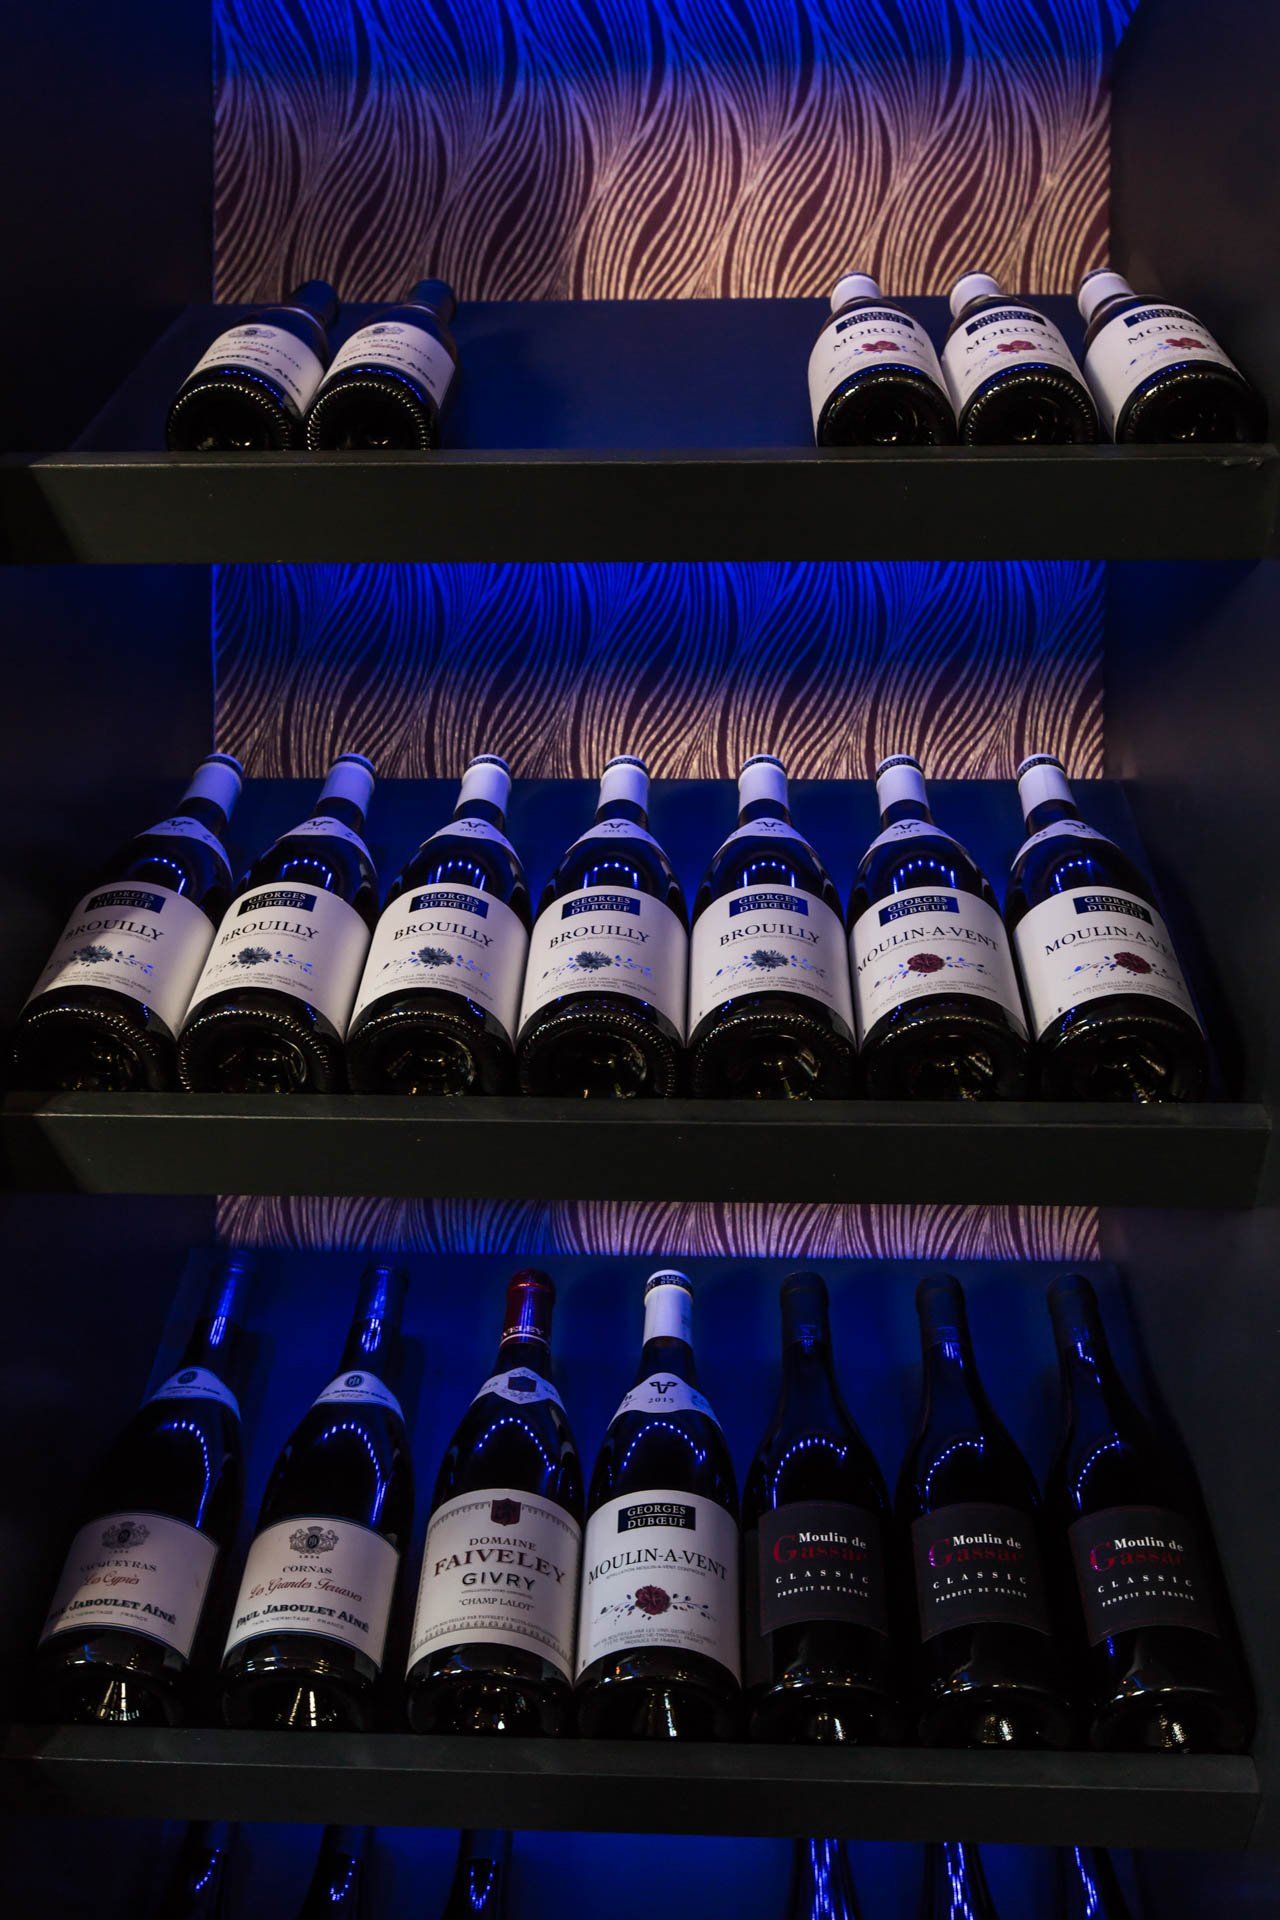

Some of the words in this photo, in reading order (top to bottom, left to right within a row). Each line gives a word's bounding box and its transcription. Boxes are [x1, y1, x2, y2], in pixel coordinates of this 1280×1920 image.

[833, 328, 925, 351] MORGON
[966, 328, 1060, 354] MORGON
[96, 891, 155, 901] GEORGES
[249, 891, 306, 904] GEORGES
[420, 892, 480, 905] GEORGES
[571, 896, 631, 907] GEORGES
[739, 893, 799, 904] GEORGES
[887, 895, 948, 912] GEORGES
[1084, 896, 1143, 912] GEORGES
[65, 920, 164, 940] BROUILLY
[221, 920, 319, 944] BROUILLY
[393, 922, 494, 947] BROUILLY
[550, 925, 650, 948] BROUILLY
[720, 924, 820, 946] BROUILLY
[857, 926, 999, 976] MOULIN-A-VENT
[627, 1504, 687, 1517] GEORGES
[469, 1536, 537, 1551] DOMAINE
[798, 1532, 847, 1543] Moulin
[851, 1537, 867, 1549] de
[952, 1533, 1003, 1547] Moulin
[1006, 1537, 1023, 1549] de
[1114, 1536, 1165, 1550] Moulin
[1168, 1540, 1185, 1551] de
[282, 1565, 332, 1574] CORNAS
[434, 1549, 567, 1584] FAIVELEY
[588, 1548, 728, 1585] MOULIN-A-VENT
[462, 1571, 536, 1591] GIVRY
[775, 1569, 869, 1584] CLASSIC
[933, 1571, 1027, 1589] CLASSIC
[1097, 1574, 1192, 1593] CLASSIC
[265, 1577, 312, 1596] Grandes
[69, 1599, 141, 1611] JABOULET
[236, 1611, 261, 1629] PAUL
[263, 1604, 336, 1618] JABOULET
